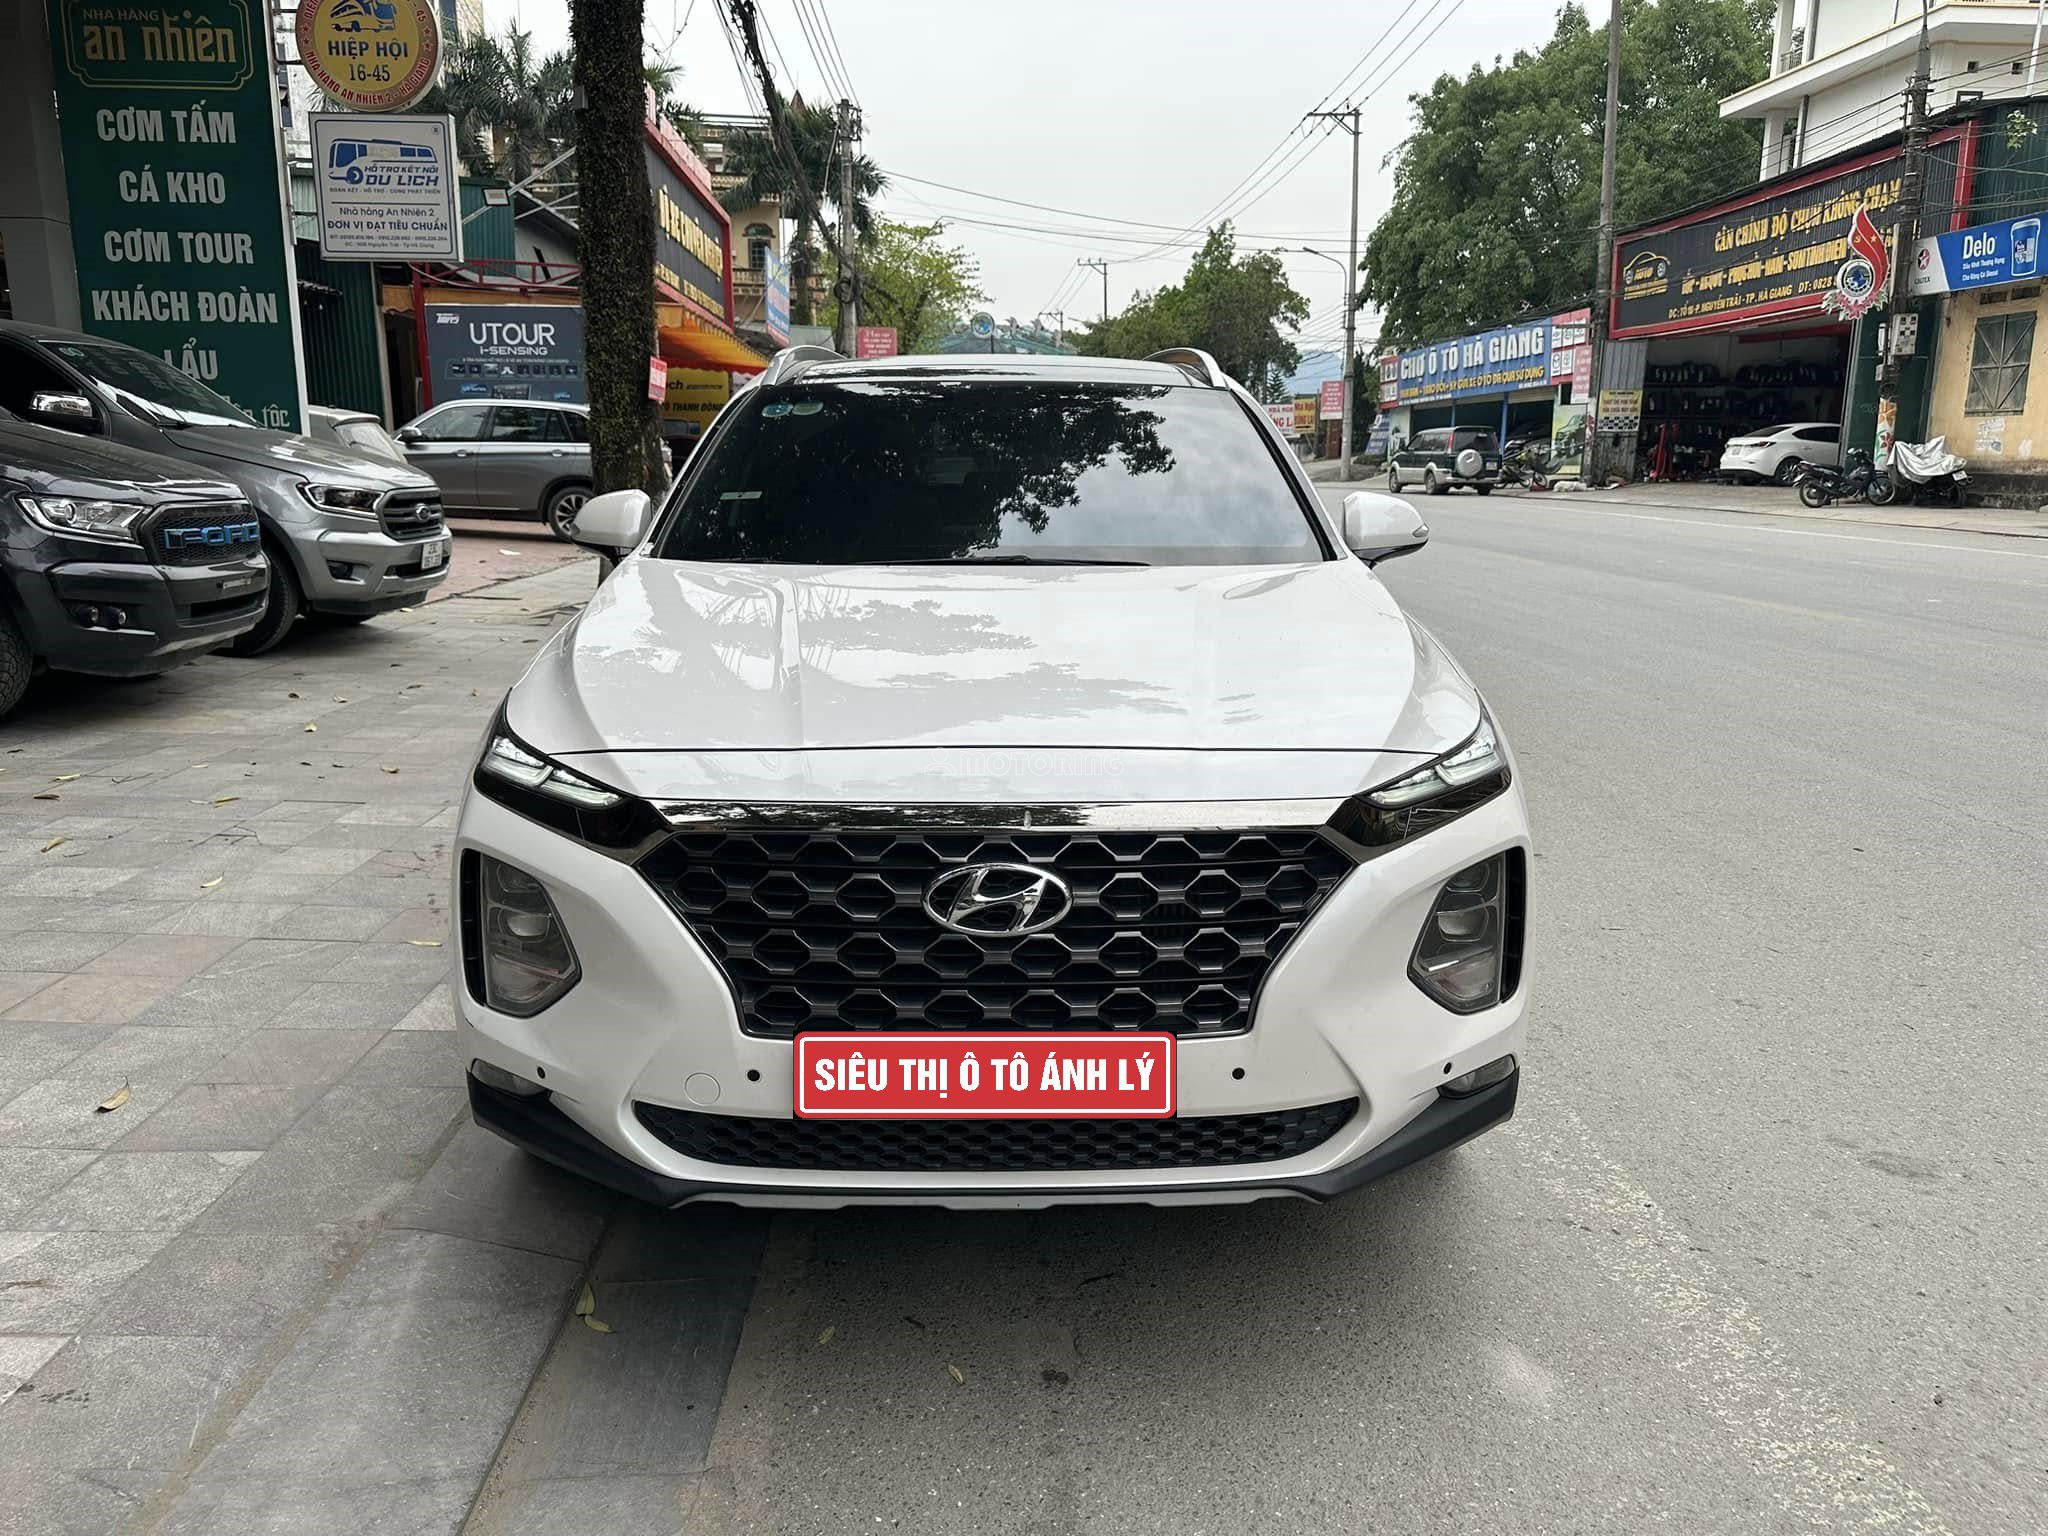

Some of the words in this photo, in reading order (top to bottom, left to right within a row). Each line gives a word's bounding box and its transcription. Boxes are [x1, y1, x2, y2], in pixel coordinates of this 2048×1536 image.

[83, 25, 127, 61] an
[142, 8, 237, 63] nhiên
[327, 37, 369, 60] HIỆP
[375, 37, 409, 61] HỘI
[349, 64, 391, 82] 16-45
[96, 106, 164, 142] CƠM
[171, 100, 237, 144] TẤM
[119, 164, 160, 202] CÁ
[166, 172, 226, 204] KHO
[366, 175, 391, 185] DU
[397, 175, 439, 187] LỊCH
[367, 221, 386, 232] ĐẠT
[386, 209, 399, 217] An
[401, 207, 427, 217] Nhiên
[429, 208, 435, 217] 2
[1771, 207, 1788, 241] ĐỘ
[104, 228, 171, 262] CƠM
[178, 232, 254, 264] TOUR
[1962, 232, 1996, 260] Delo
[91, 284, 190, 321] KHÁCH
[198, 286, 278, 323] ĐOÀN
[469, 323, 556, 346] UTOUR
[1400, 353, 1427, 384] CHỢ
[1428, 349, 1437, 374] Ô
[1441, 341, 1459, 372] TÔ
[1463, 335, 1484, 368] HÀ
[1488, 326, 1545, 363] GIANG
